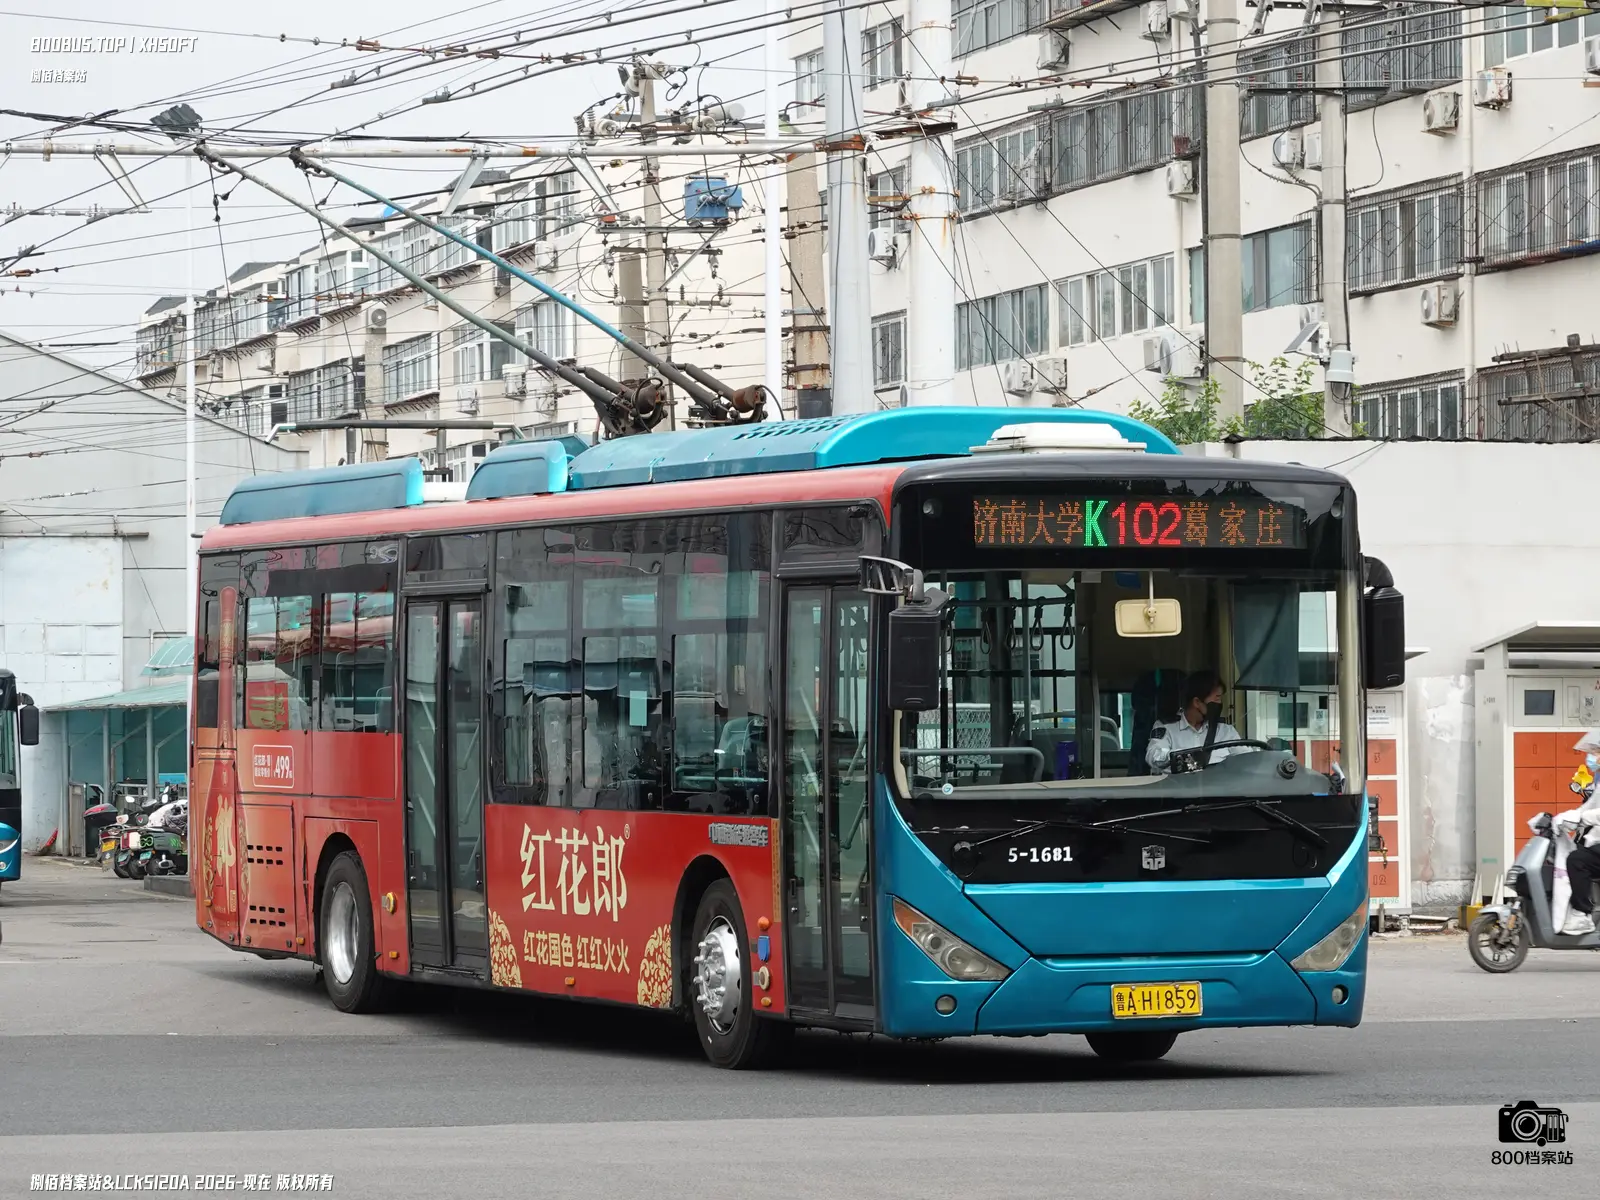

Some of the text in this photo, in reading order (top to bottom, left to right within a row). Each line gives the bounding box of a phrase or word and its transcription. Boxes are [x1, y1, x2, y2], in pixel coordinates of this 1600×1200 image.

[974, 499, 1283, 547] 济南大学 K102 葛家庄
[519, 822, 628, 923] 红花郎
[1008, 846, 1073, 863] 5-1681
[1372, 874, 1387, 886] 12
[523, 930, 630, 974] 红花国色 红红火火
